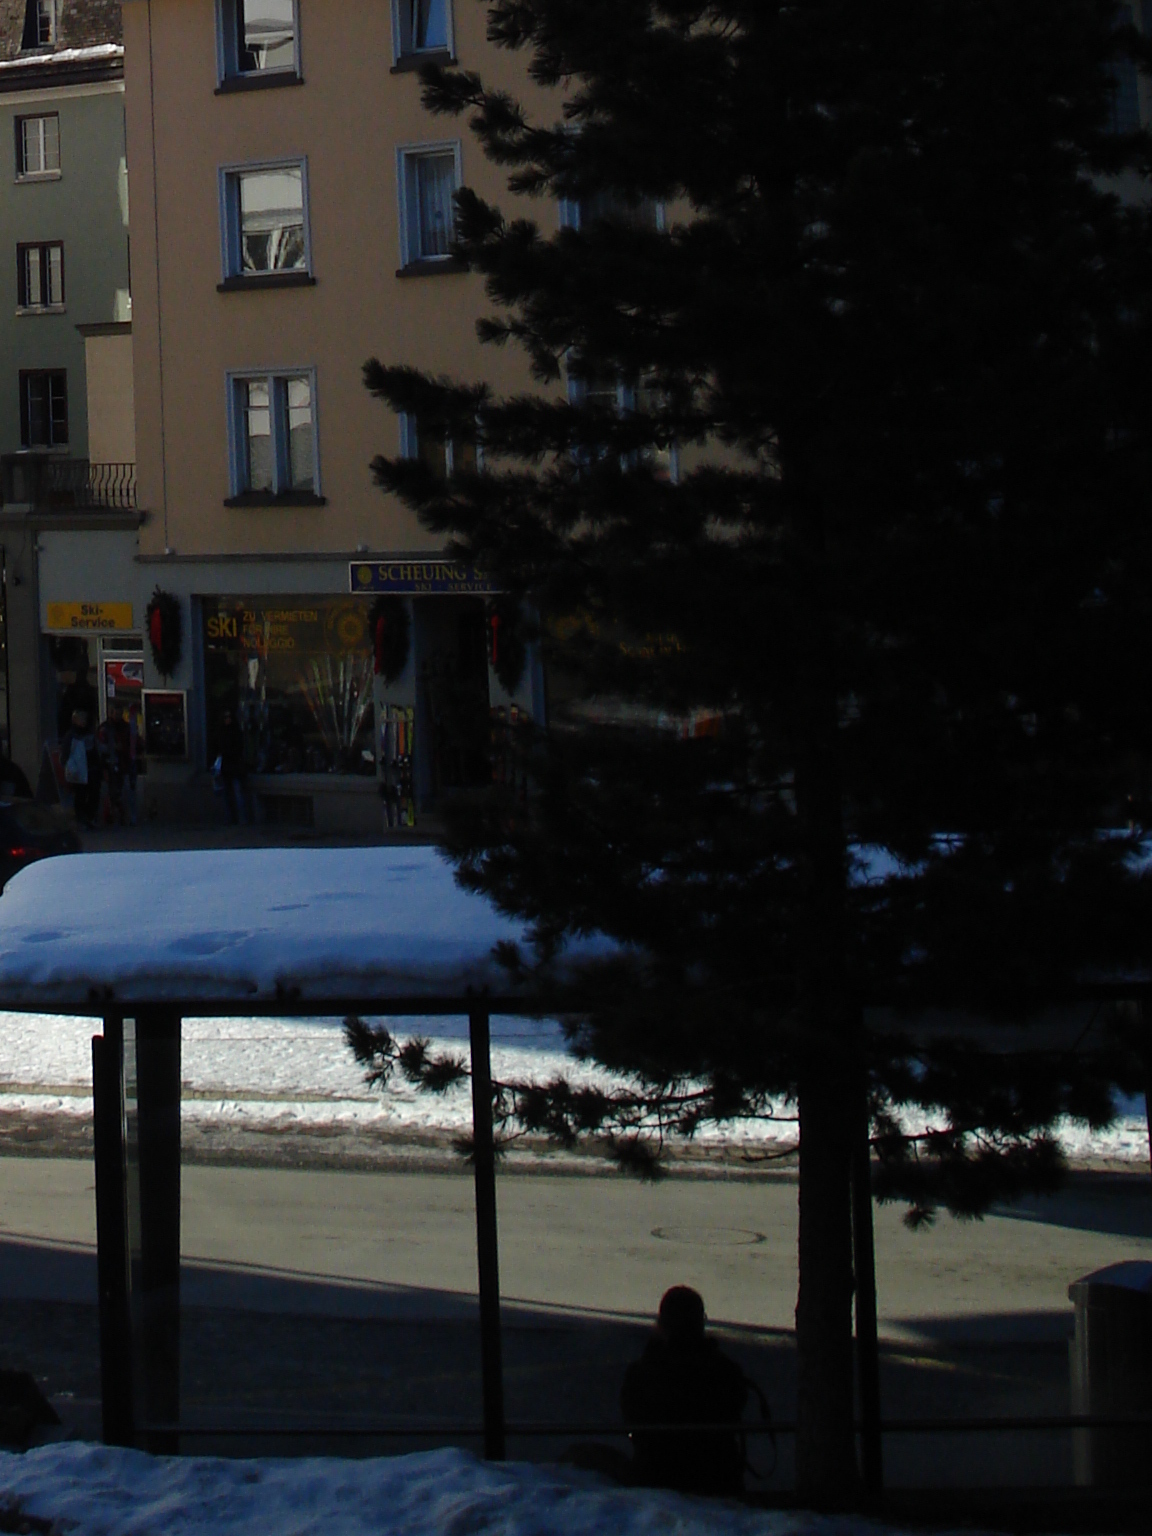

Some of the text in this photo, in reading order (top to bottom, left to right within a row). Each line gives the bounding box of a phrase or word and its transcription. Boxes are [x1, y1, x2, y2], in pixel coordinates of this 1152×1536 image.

[378, 564, 466, 581] SCHEUING
[81, 604, 103, 615] Ski-
[70, 616, 116, 628] Service
[208, 617, 237, 638] SKI
